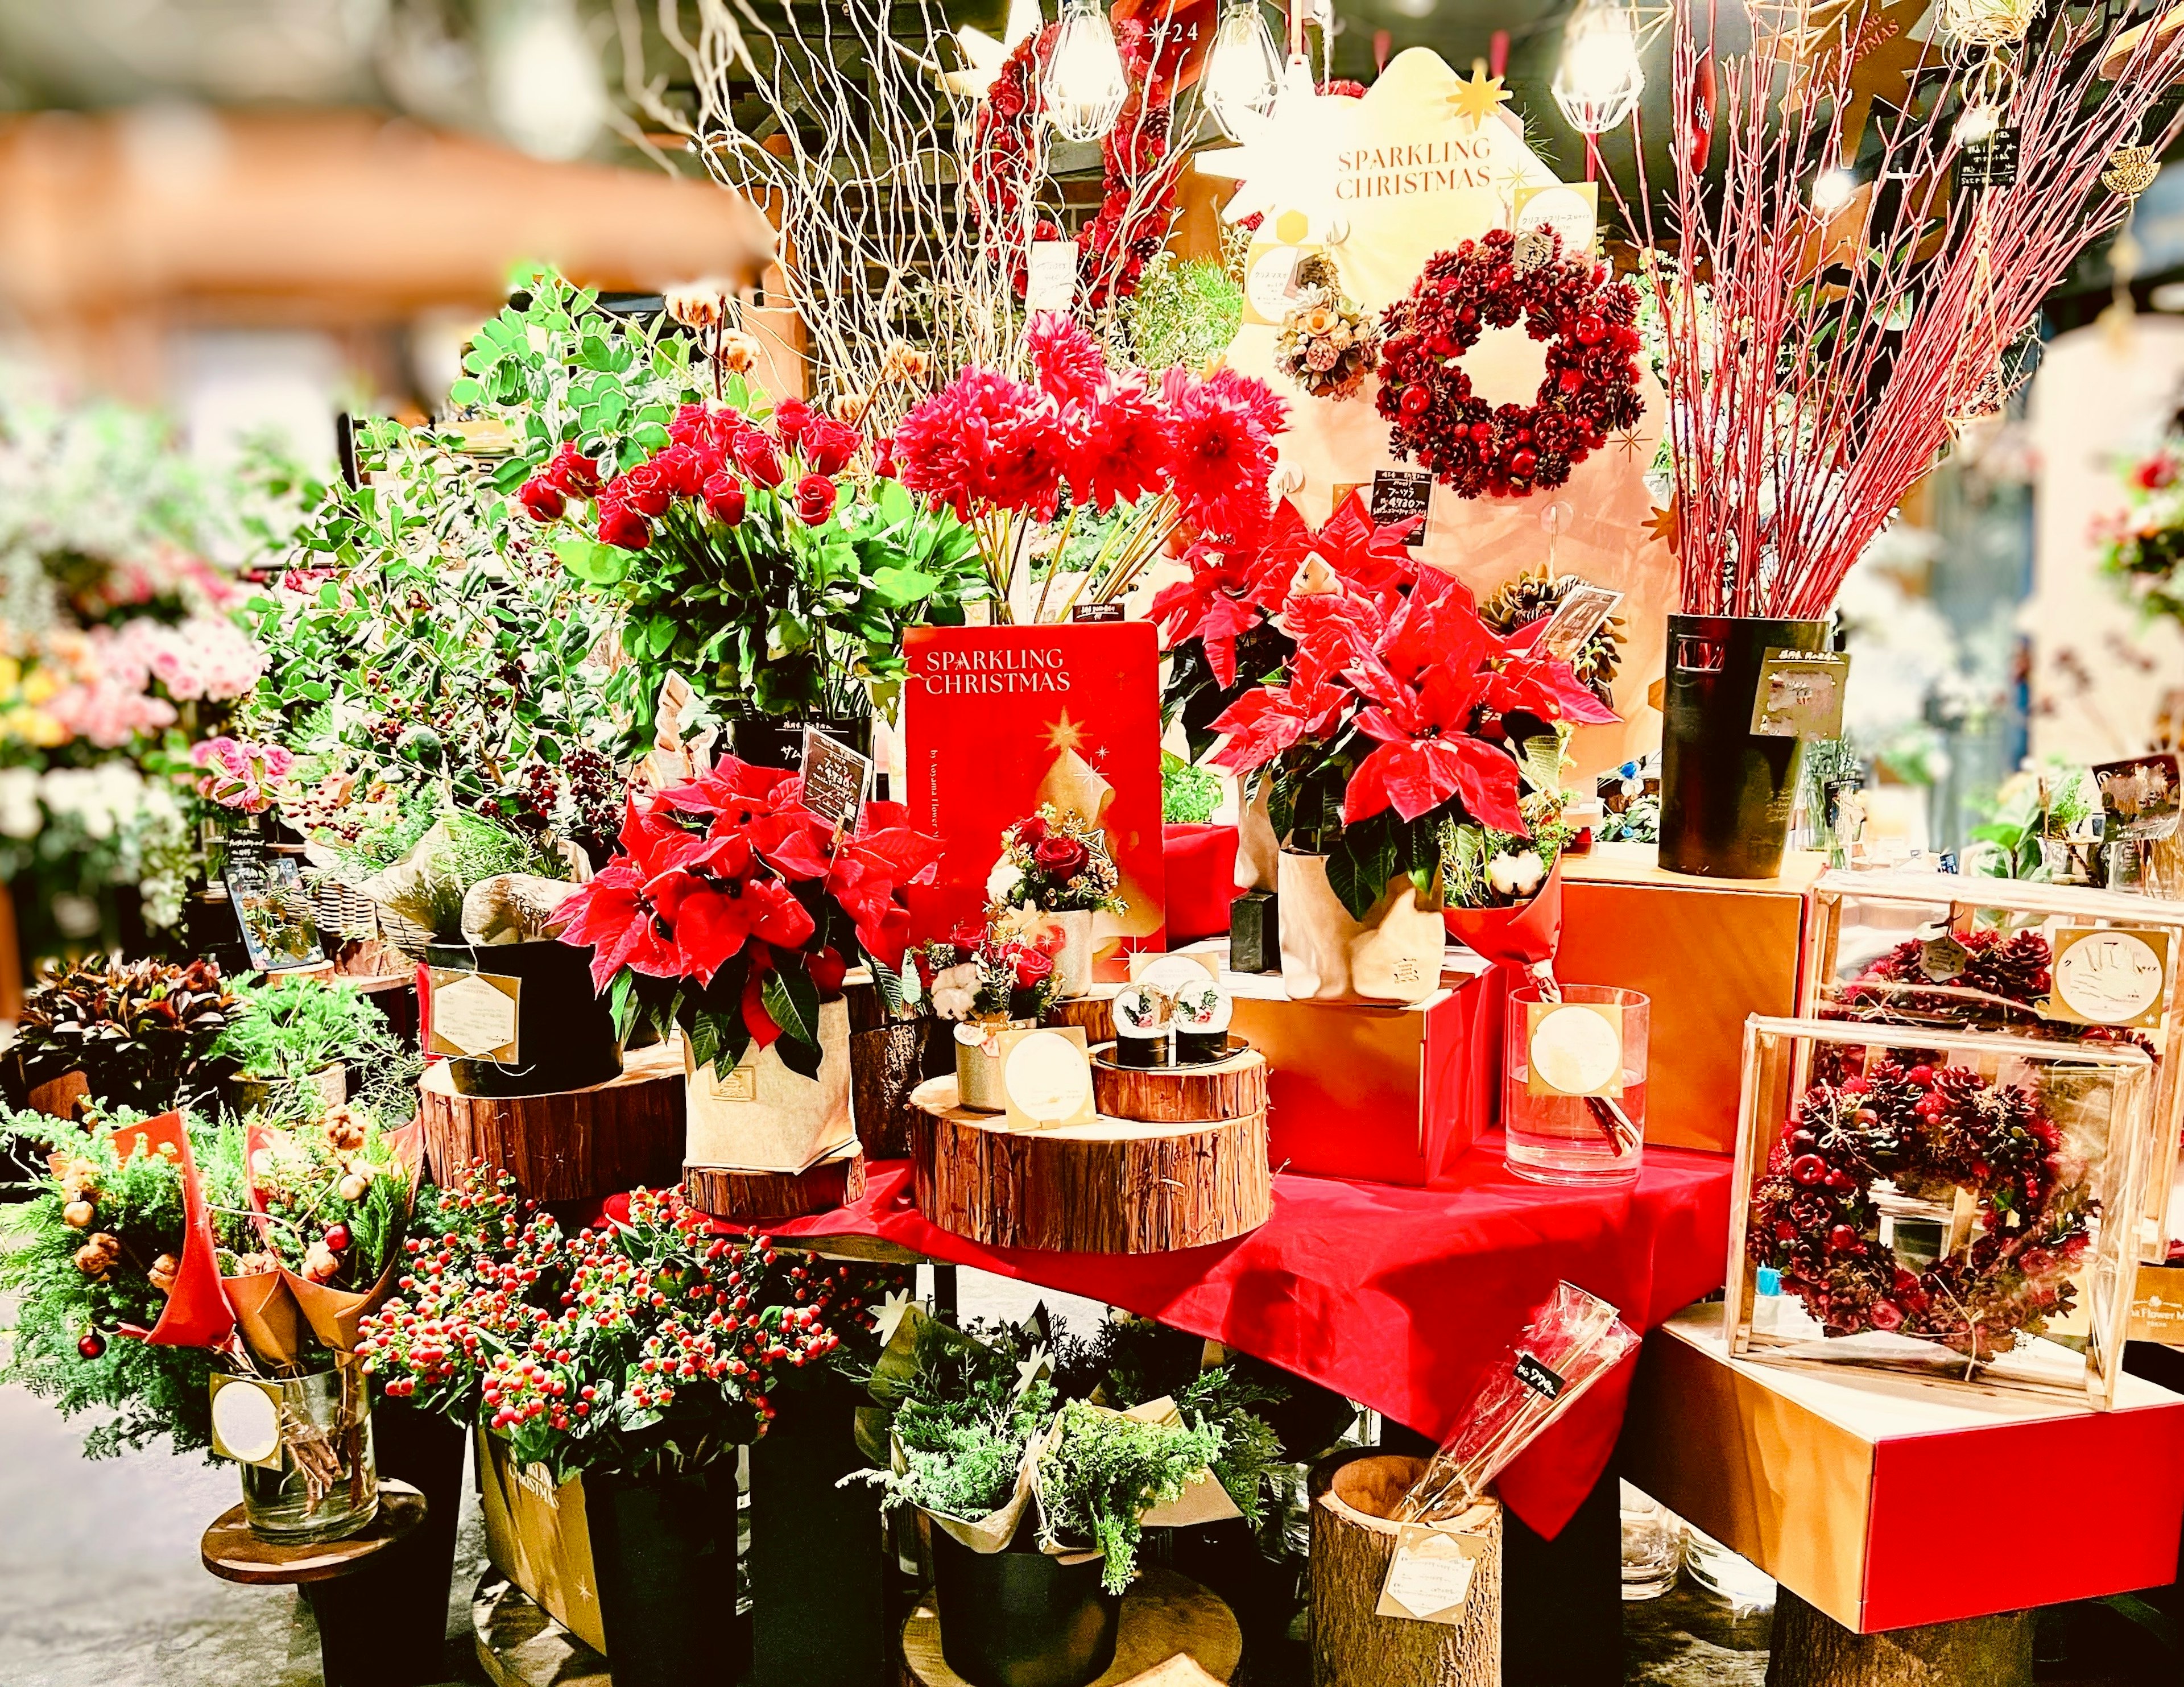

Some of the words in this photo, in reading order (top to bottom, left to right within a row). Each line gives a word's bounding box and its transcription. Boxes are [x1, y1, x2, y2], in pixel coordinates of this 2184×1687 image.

[1338, 138, 1490, 172] SPARKLING
[1336, 166, 1490, 200] CHRISTMAS
[926, 648, 1064, 672] SPARKLING
[925, 671, 1070, 694] CHRISTMAS
[929, 749, 938, 759] by
[929, 763, 938, 796] Aoyama
[931, 798, 940, 828] Flower
[2141, 1308, 2175, 1320] Flower
